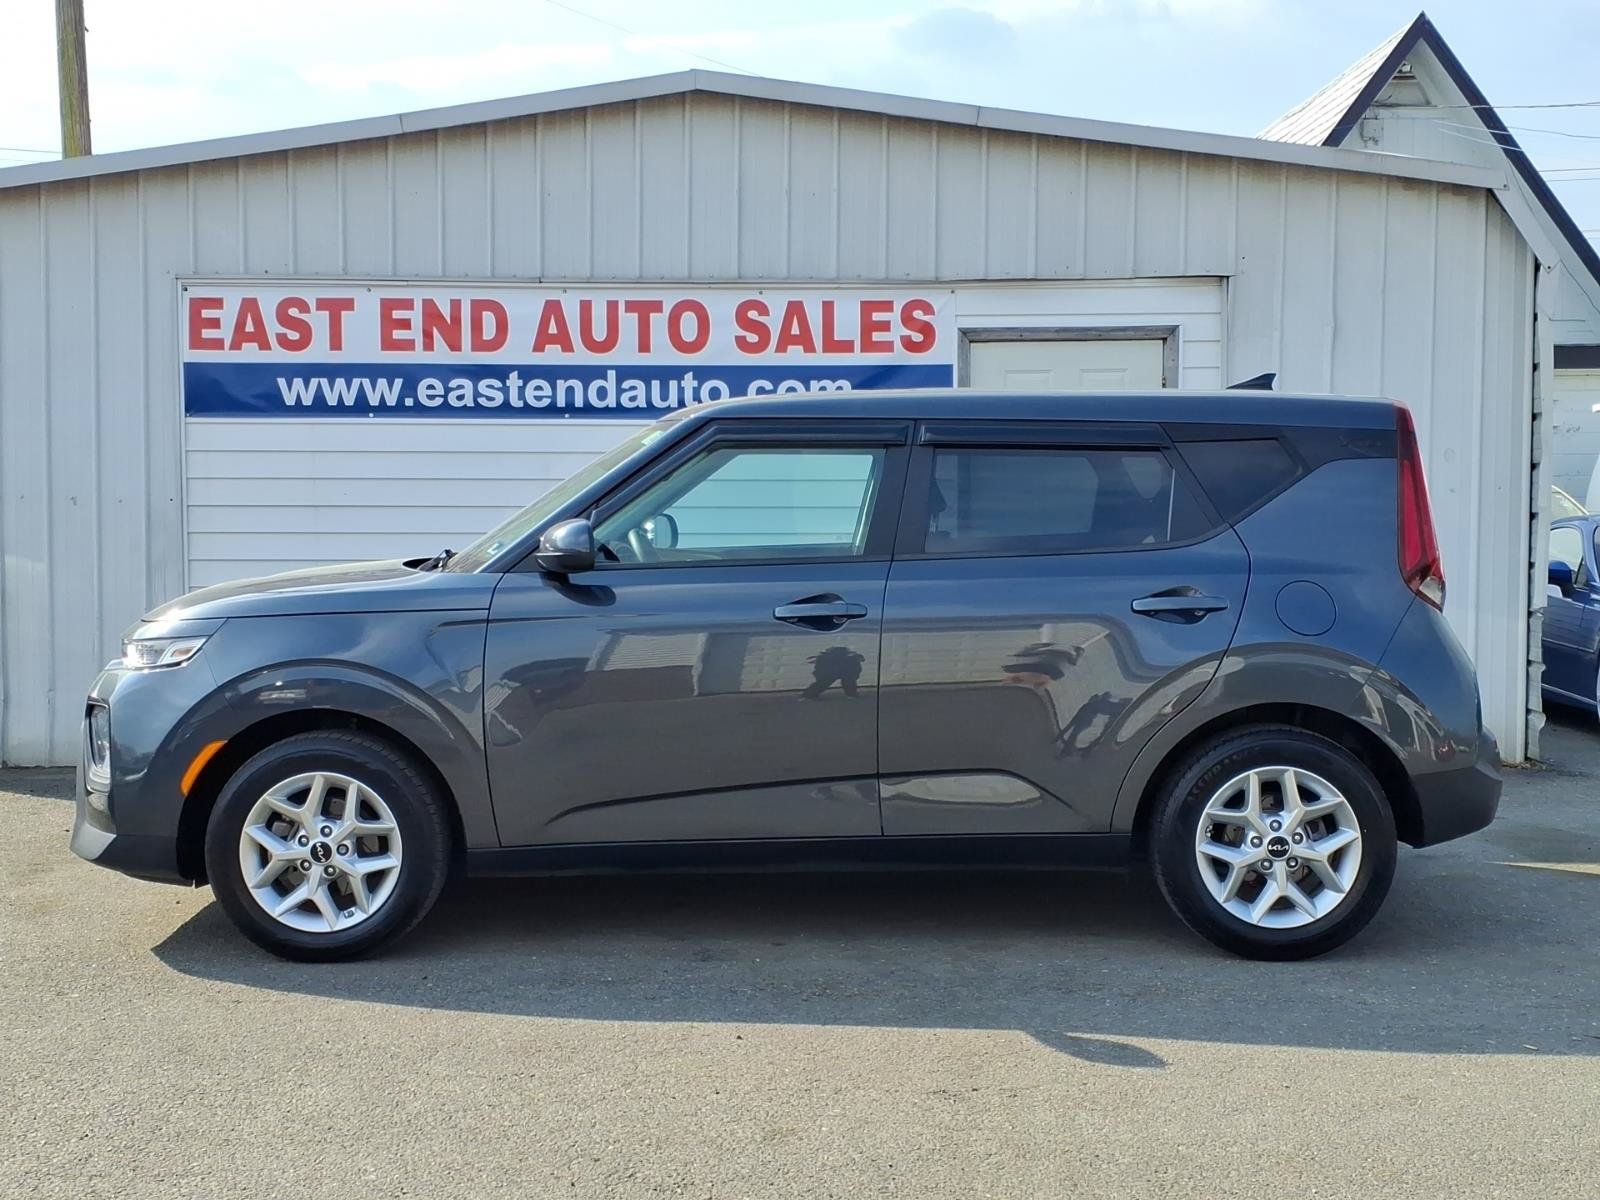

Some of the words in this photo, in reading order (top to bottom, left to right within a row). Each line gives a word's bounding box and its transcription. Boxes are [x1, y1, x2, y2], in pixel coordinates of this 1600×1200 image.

[188, 297, 355, 352] EAST
[380, 298, 509, 353] END
[532, 299, 711, 354] AUTO
[734, 299, 937, 354] SALES
[277, 371, 852, 408] www.eastendautoc
